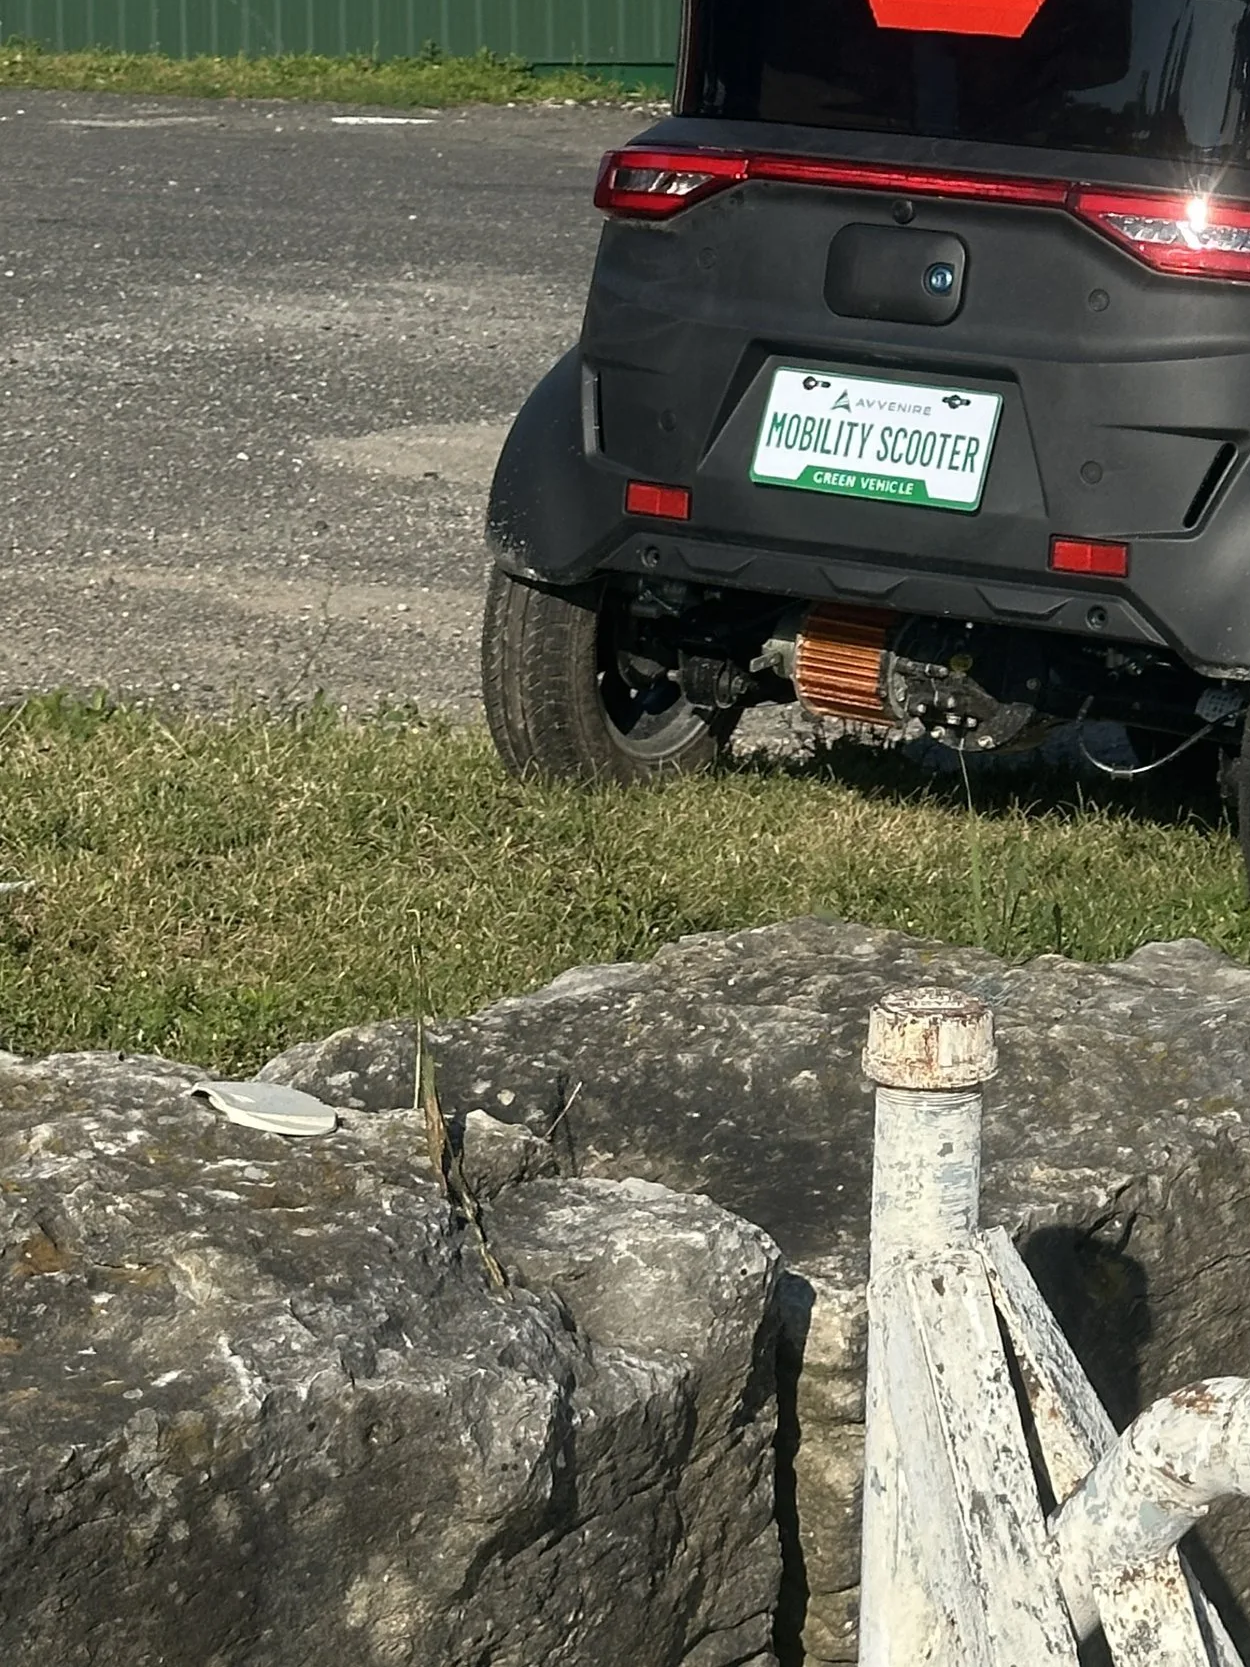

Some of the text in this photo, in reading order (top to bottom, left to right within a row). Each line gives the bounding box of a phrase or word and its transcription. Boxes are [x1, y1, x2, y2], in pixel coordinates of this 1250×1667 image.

[855, 397, 932, 416] AVVENIRE
[765, 411, 980, 473] MOBILITY SCOOTER
[813, 471, 914, 496] GREEN VEHICLE
